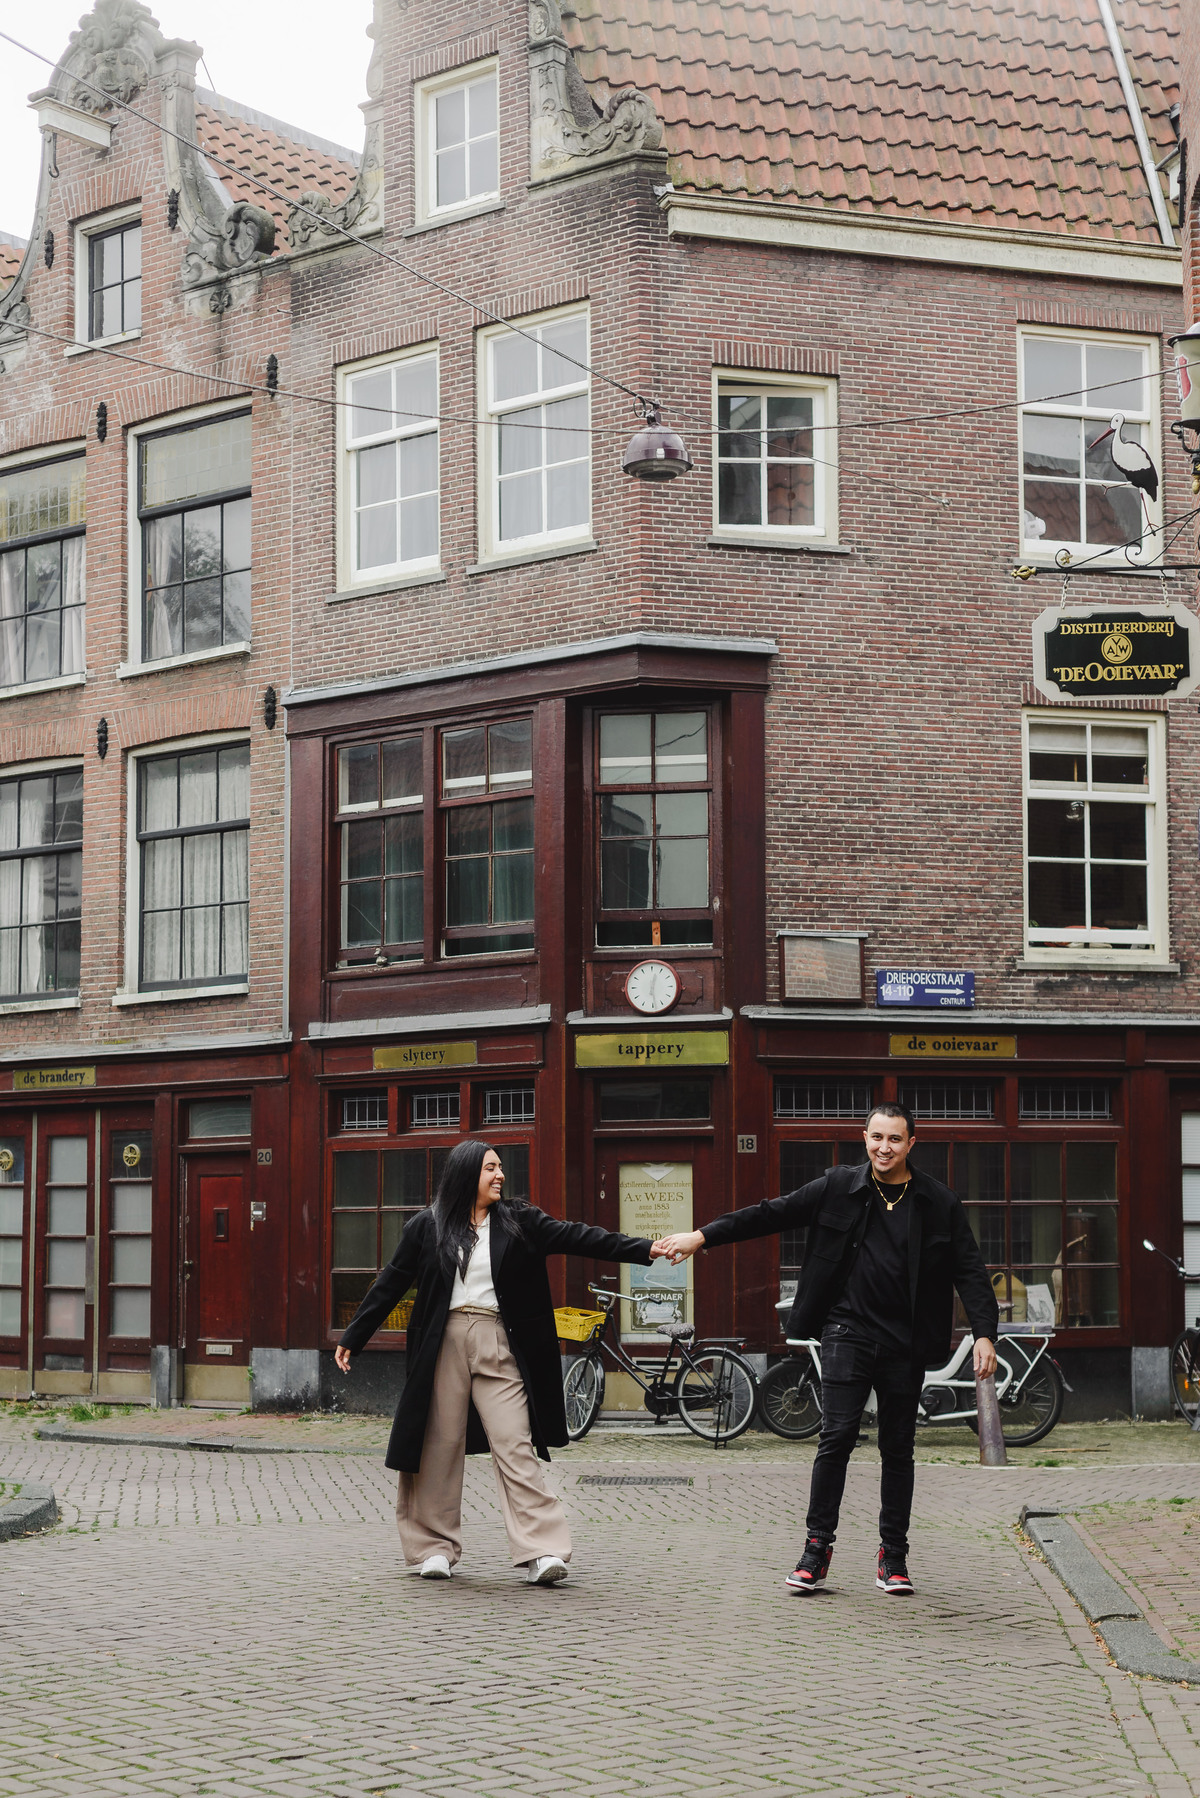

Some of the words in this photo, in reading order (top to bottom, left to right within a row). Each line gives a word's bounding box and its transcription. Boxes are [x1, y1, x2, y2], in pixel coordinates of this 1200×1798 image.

[1060, 622, 1175, 637] DISTILLEERDERIJ
[886, 972, 966, 985] DRIEHOEKSTRAAT
[880, 985, 914, 997] 14-110
[940, 997, 966, 1005] CENTRUM
[908, 1036, 926, 1050] de
[932, 1037, 998, 1051] ooievaar
[402, 1048, 446, 1065] slytery
[618, 1043, 684, 1059] tappery
[23, 1072, 36, 1084] de
[39, 1069, 86, 1085] brandery
[739, 1138, 754, 1150] 18
[257, 1151, 272, 1162] 20
[644, 1191, 684, 1202] WEES
